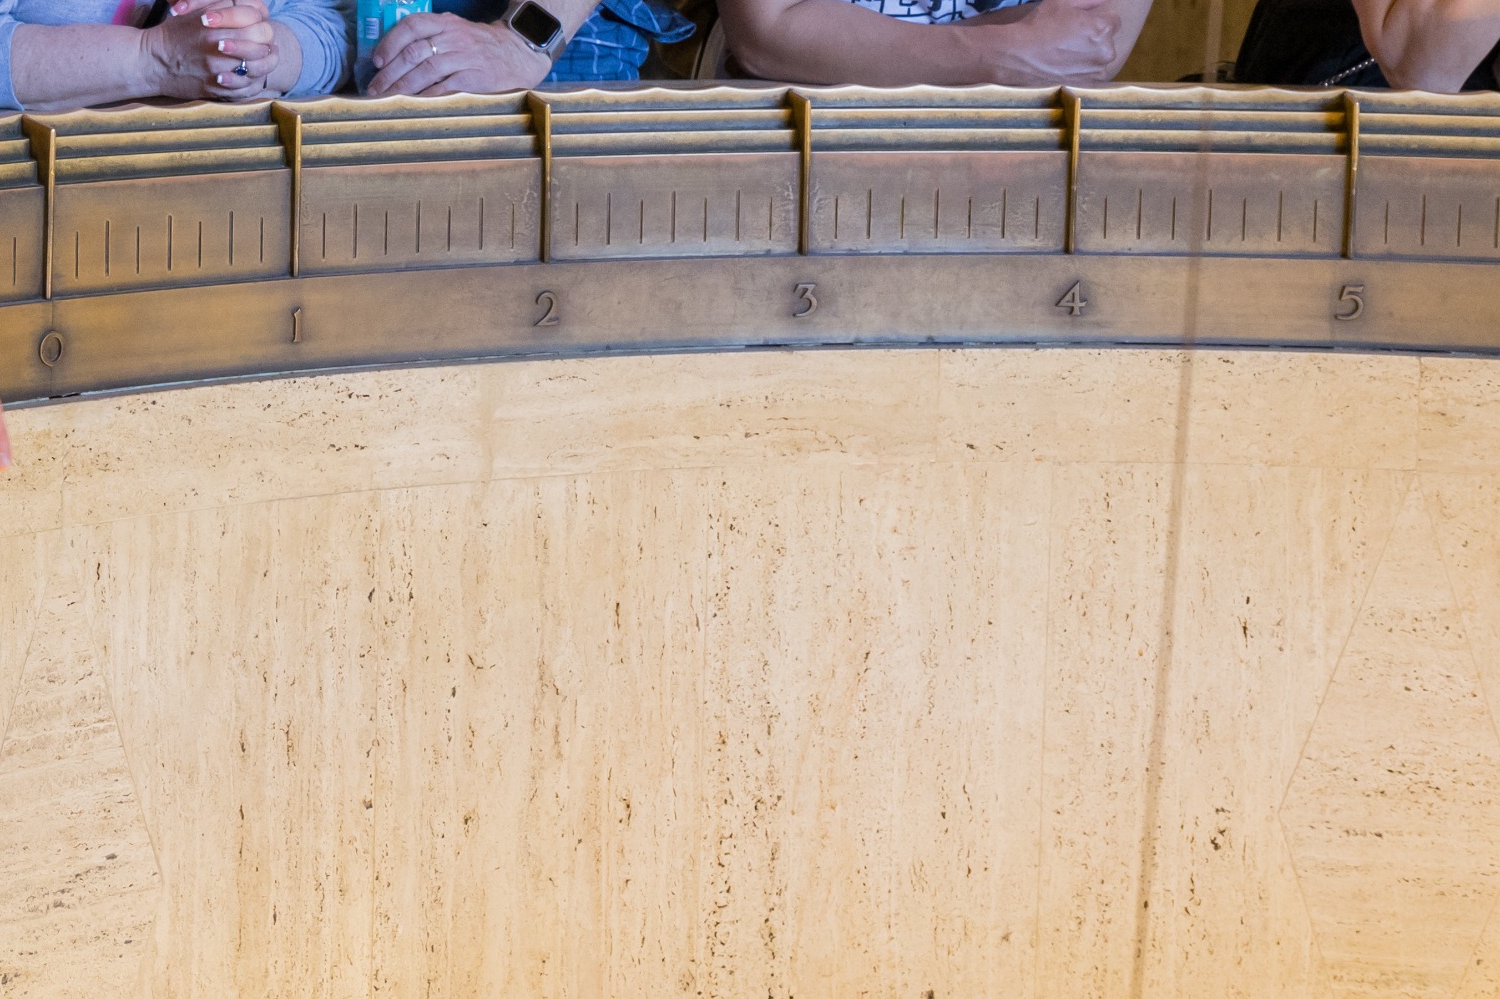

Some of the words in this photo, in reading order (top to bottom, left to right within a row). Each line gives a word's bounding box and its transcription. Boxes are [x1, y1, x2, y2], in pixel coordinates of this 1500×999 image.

[533, 290, 560, 327] 2
[792, 281, 818, 318] 3
[1055, 280, 1088, 318] 4
[1335, 284, 1365, 321] 5
[292, 306, 302, 343] 1
[38, 330, 65, 368] 0
